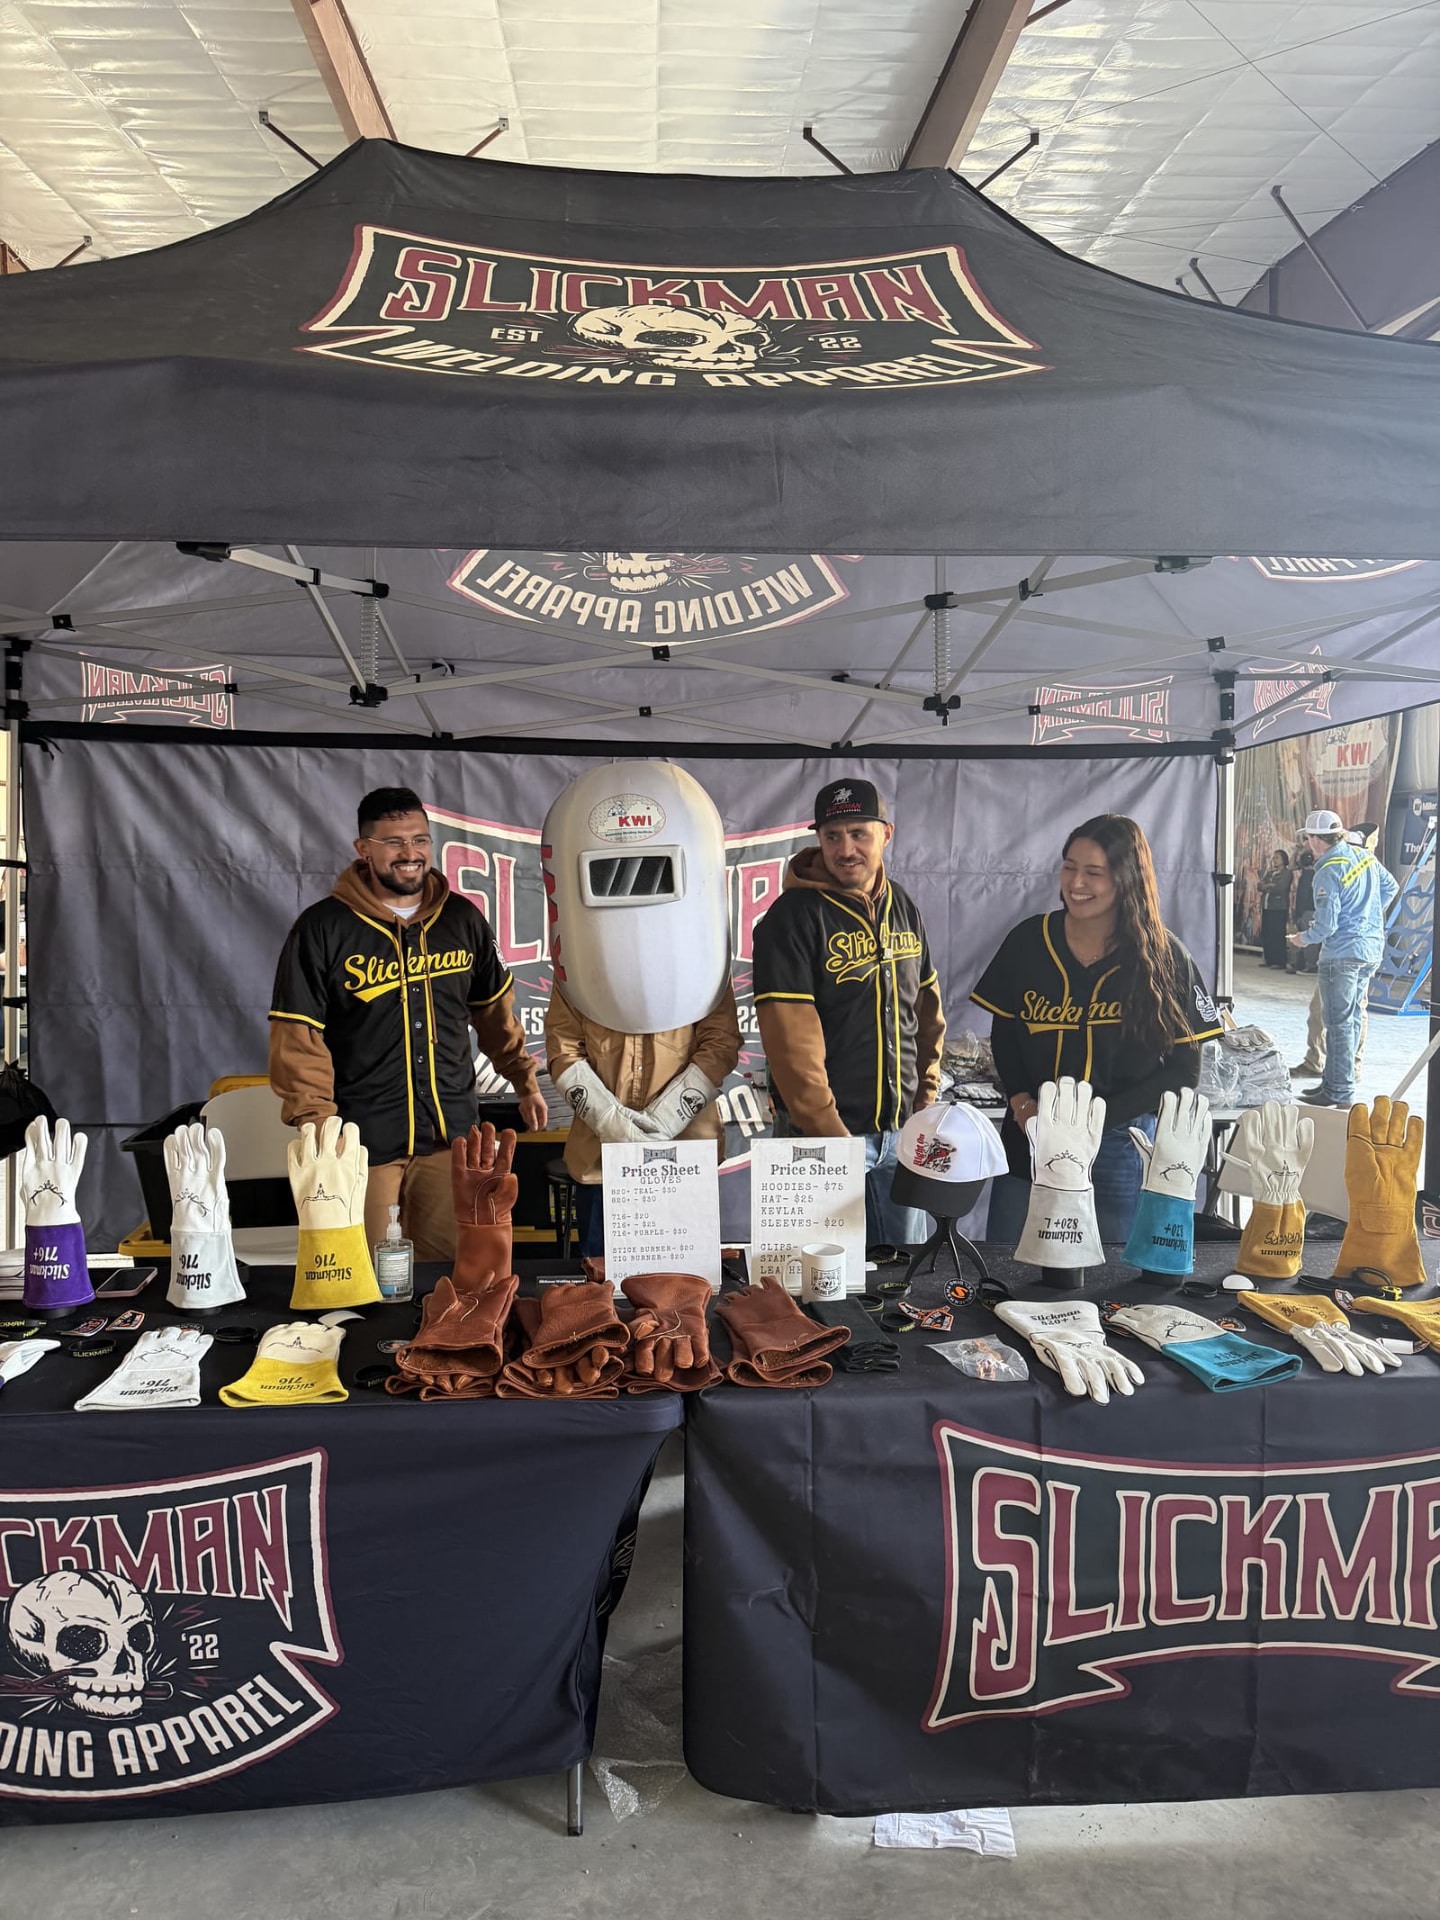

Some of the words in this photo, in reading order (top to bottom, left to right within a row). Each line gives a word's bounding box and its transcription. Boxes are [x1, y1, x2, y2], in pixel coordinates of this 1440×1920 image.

[379, 245, 959, 335] SLICKMAN
[490, 326, 540, 344] EST
[372, 338, 677, 389] WELDING
[701, 352, 999, 389] APPAREL
[618, 815, 652, 827] KWI
[344, 946, 474, 990] Slickman
[1019, 989, 1122, 1023] Slickma
[520, 1006, 549, 1035] ES
[621, 1166, 658, 1178] Price
[661, 1163, 701, 1176] Sheet
[770, 1163, 806, 1176] Price
[809, 1162, 849, 1176] Sheet
[640, 1175, 682, 1185] GLOVES
[761, 1182, 819, 1191] HOODIES-
[823, 1181, 844, 1192] $75
[761, 1194, 789, 1204] HAT-
[793, 1193, 814, 1204] $25
[760, 1206, 804, 1215] KEVLAR
[760, 1218, 819, 1228] SLEEVES-
[823, 1217, 845, 1229] $20
[1044, 1217, 1051, 1228] L
[1053, 1217, 1079, 1230] 820+
[1038, 1229, 1084, 1244] Slickman
[760, 1243, 799, 1251] CLIPS-
[33, 1246, 59, 1262] 716+
[760, 1254, 792, 1263] STAN
[1260, 1249, 1300, 1258] ickman
[314, 1253, 337, 1268] 716
[29, 1264, 71, 1280] Slickman
[304, 1267, 353, 1281] Slickman
[73, 1346, 114, 1358] SLICKMAN
[139, 1378, 171, 1388] 716+
[279, 1376, 303, 1385] 716
[119, 1386, 179, 1397] Slickman
[259, 1382, 316, 1392] Slickman
[108, 1674, 304, 1776] APPAREL
